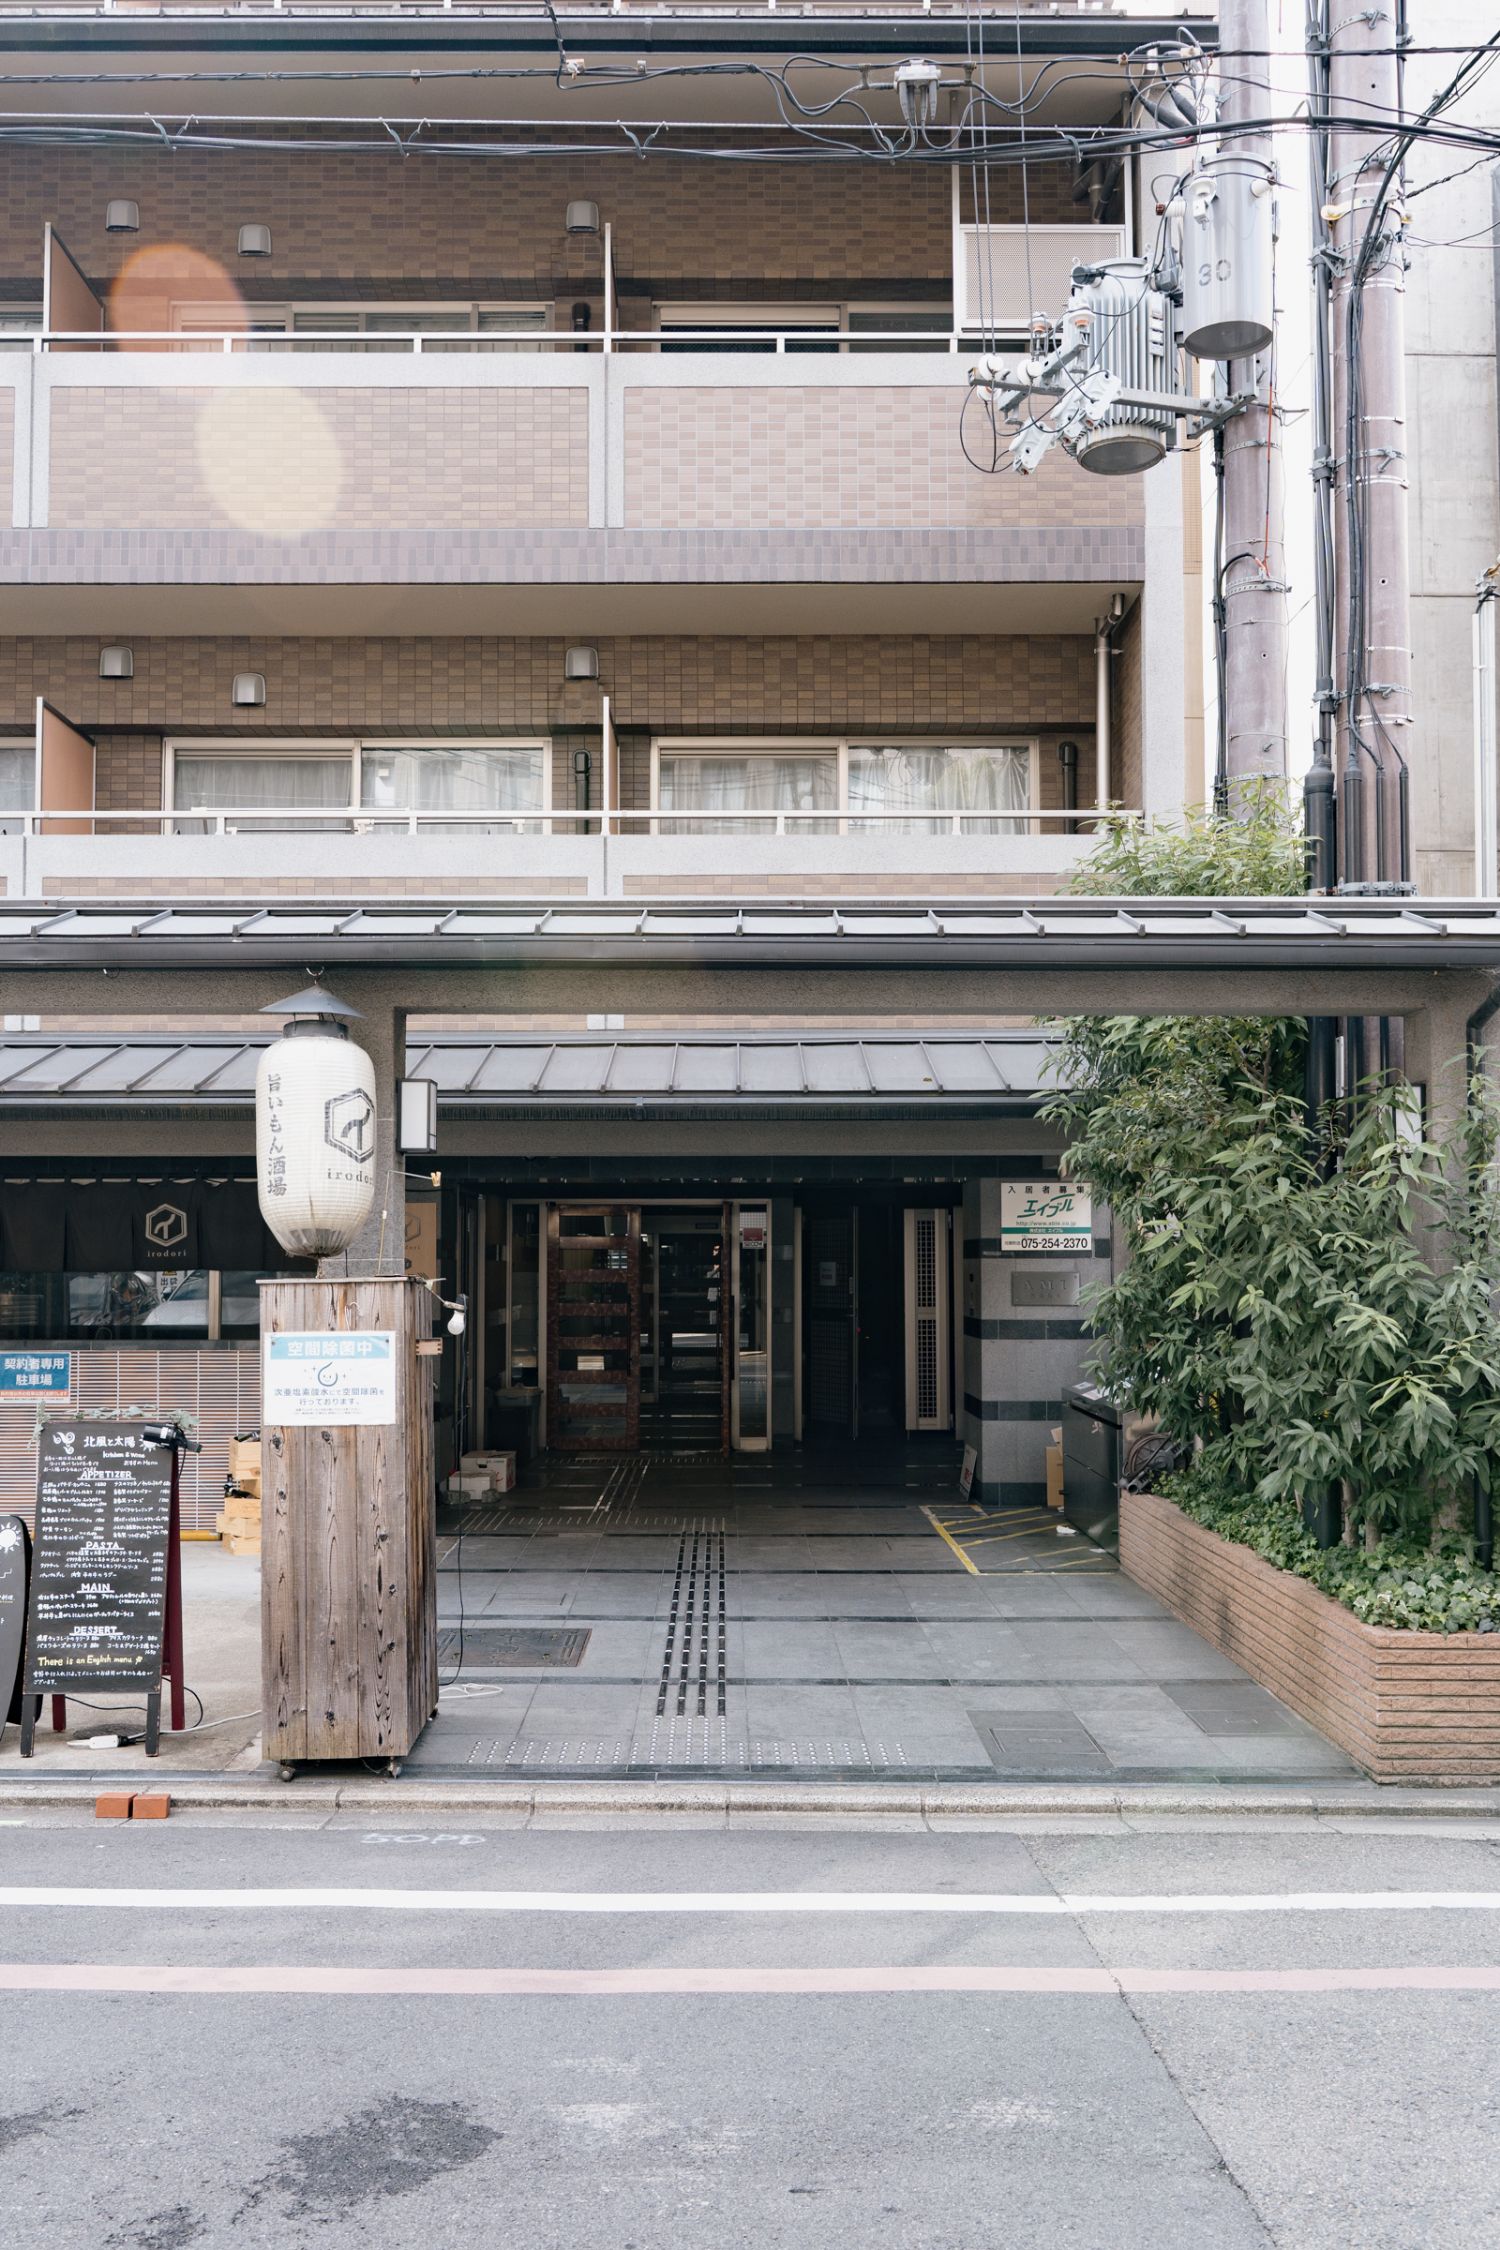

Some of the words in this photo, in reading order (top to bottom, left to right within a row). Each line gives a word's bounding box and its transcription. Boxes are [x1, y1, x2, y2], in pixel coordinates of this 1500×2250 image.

[1198, 259, 1231, 287] 30
[267, 1073, 287, 1196] 旨いもん酒場
[1007, 1185, 1085, 1194] 入居者募集
[1018, 1194, 1075, 1218] エイブル
[1021, 1238, 1088, 1249] 075-254-2370
[147, 1249, 187, 1257] irodori
[288, 1340, 372, 1357] 空間除菌中
[4, 1357, 64, 1370] 契約者専用
[16, 1373, 52, 1386] 駐車場
[299, 1398, 360, 1406] 行っております。
[83, 1435, 136, 1448] 北風と太陽
[80, 1470, 132, 1479] APPETIZER
[86, 1541, 120, 1550] PASTA
[81, 1583, 111, 1592] MAIN
[74, 1625, 118, 1634] DESSERT
[37, 1656, 63, 1666] There
[66, 1657, 74, 1665] is
[86, 1654, 111, 1665] English
